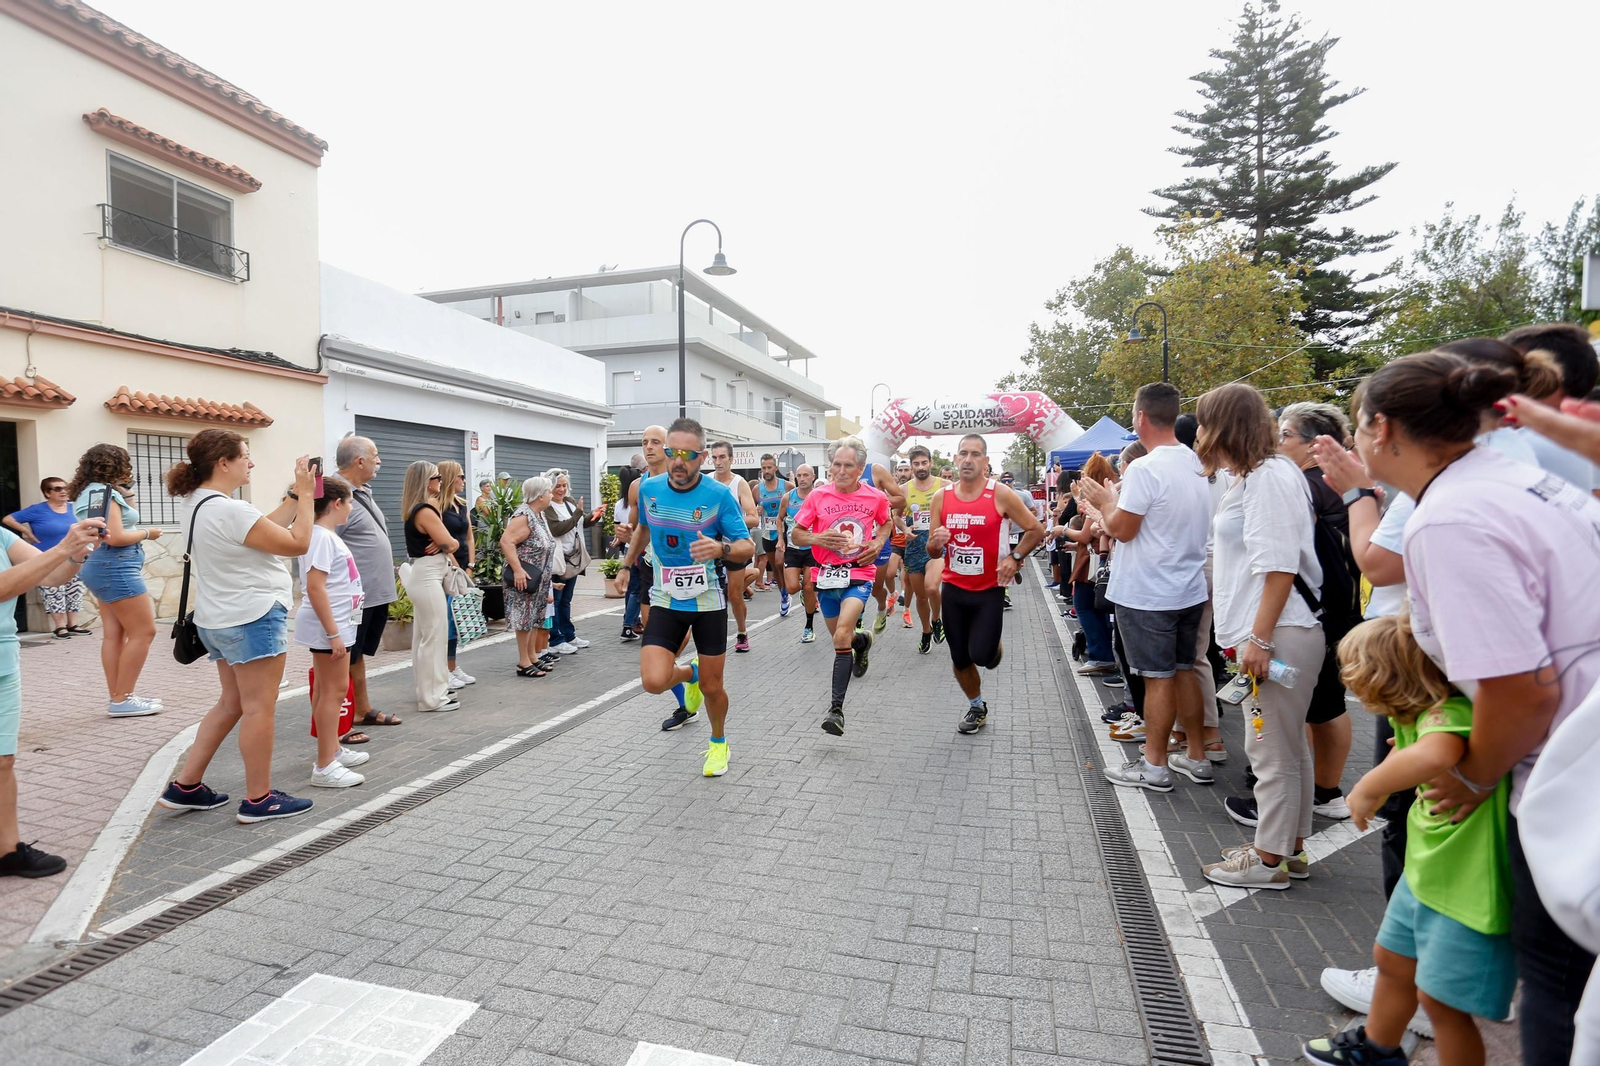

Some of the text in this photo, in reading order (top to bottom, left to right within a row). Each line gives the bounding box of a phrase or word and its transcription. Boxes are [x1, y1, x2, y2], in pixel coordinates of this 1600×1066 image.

[943, 408, 1005, 420] SOLIDARIA
[933, 417, 1016, 430] DE PALMONES
[956, 555, 981, 565] 467
[825, 569, 849, 578] 543
[674, 575, 705, 587] 674
